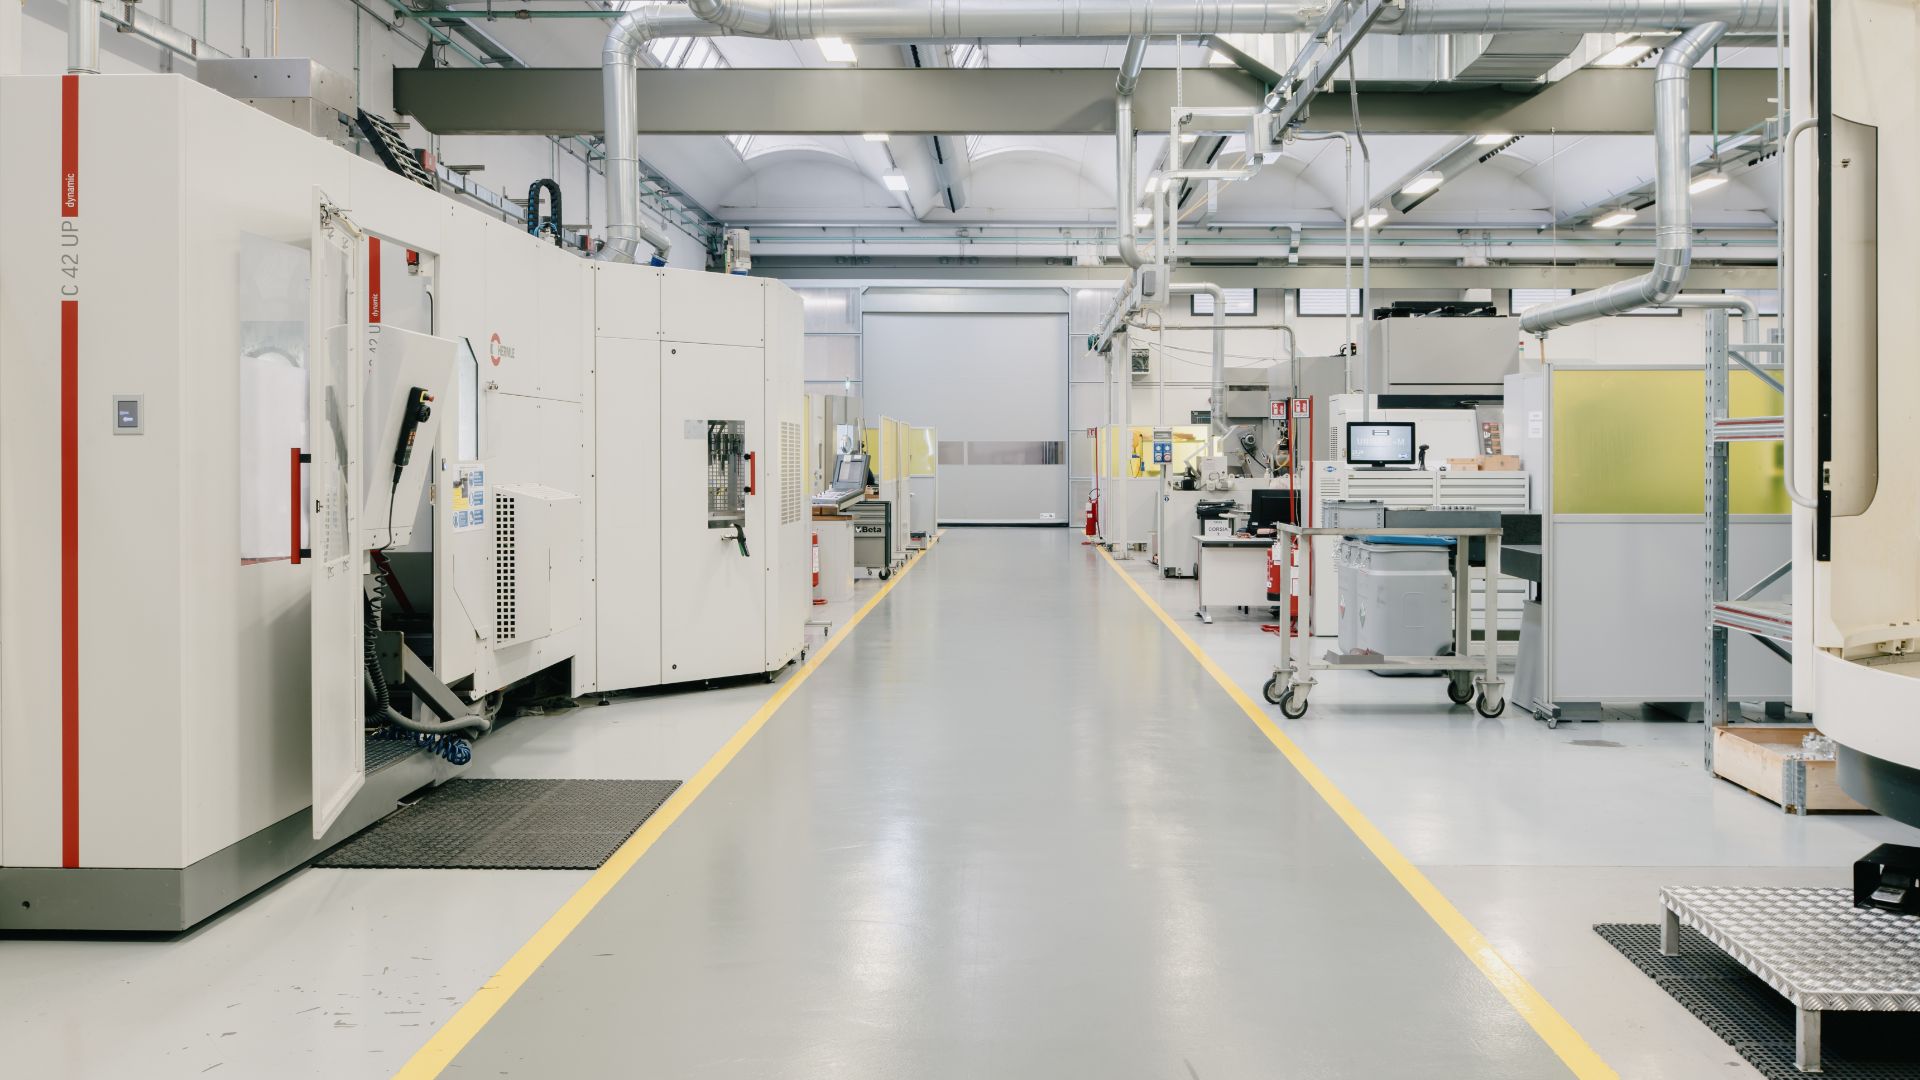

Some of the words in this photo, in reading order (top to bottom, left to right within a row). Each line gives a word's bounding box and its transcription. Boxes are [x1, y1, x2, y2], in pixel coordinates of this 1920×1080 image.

[65, 173, 76, 208] dynamic
[61, 221, 79, 246] UP
[61, 254, 79, 278] 42
[61, 285, 79, 296] C
